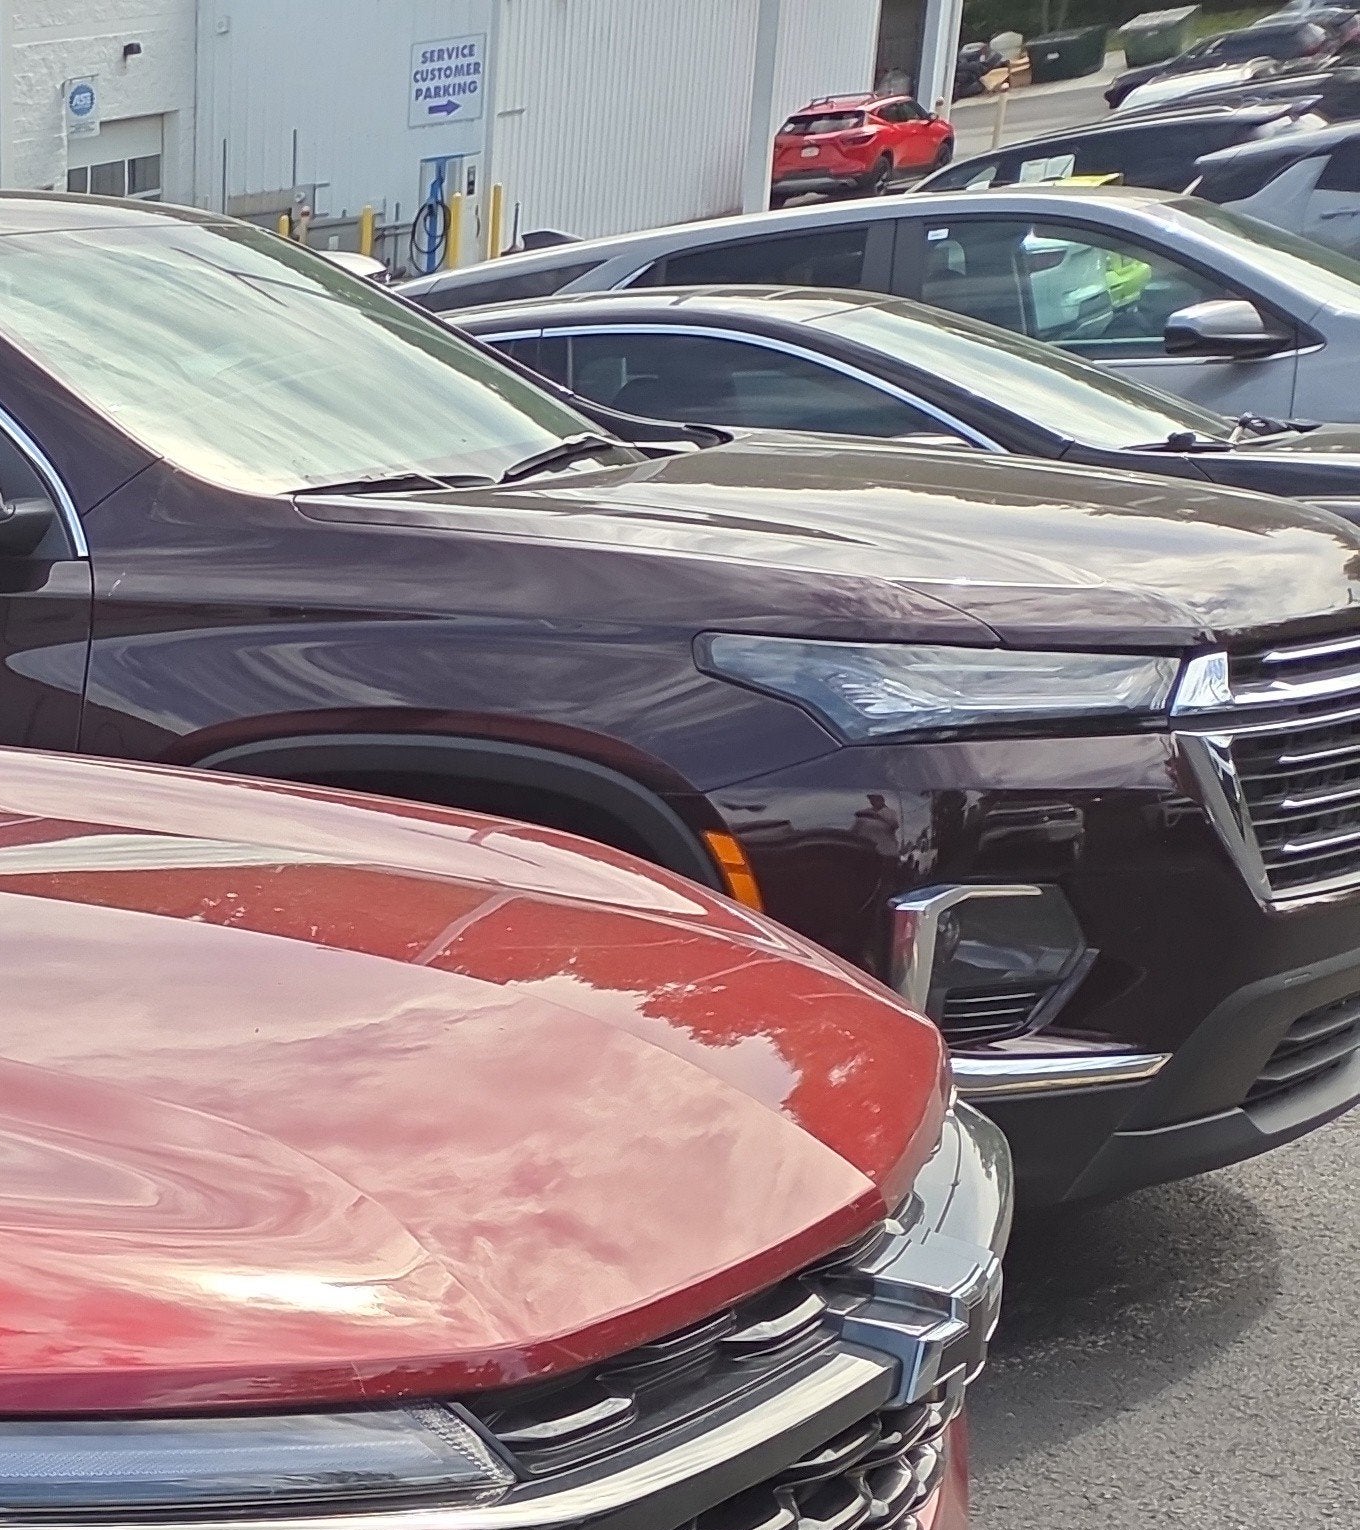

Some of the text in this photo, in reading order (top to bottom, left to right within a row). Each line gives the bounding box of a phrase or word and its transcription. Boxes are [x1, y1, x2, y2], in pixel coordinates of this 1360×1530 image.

[421, 43, 476, 65] SERVICE
[412, 61, 482, 84] CUSTOMER
[414, 80, 478, 102] PARKING
